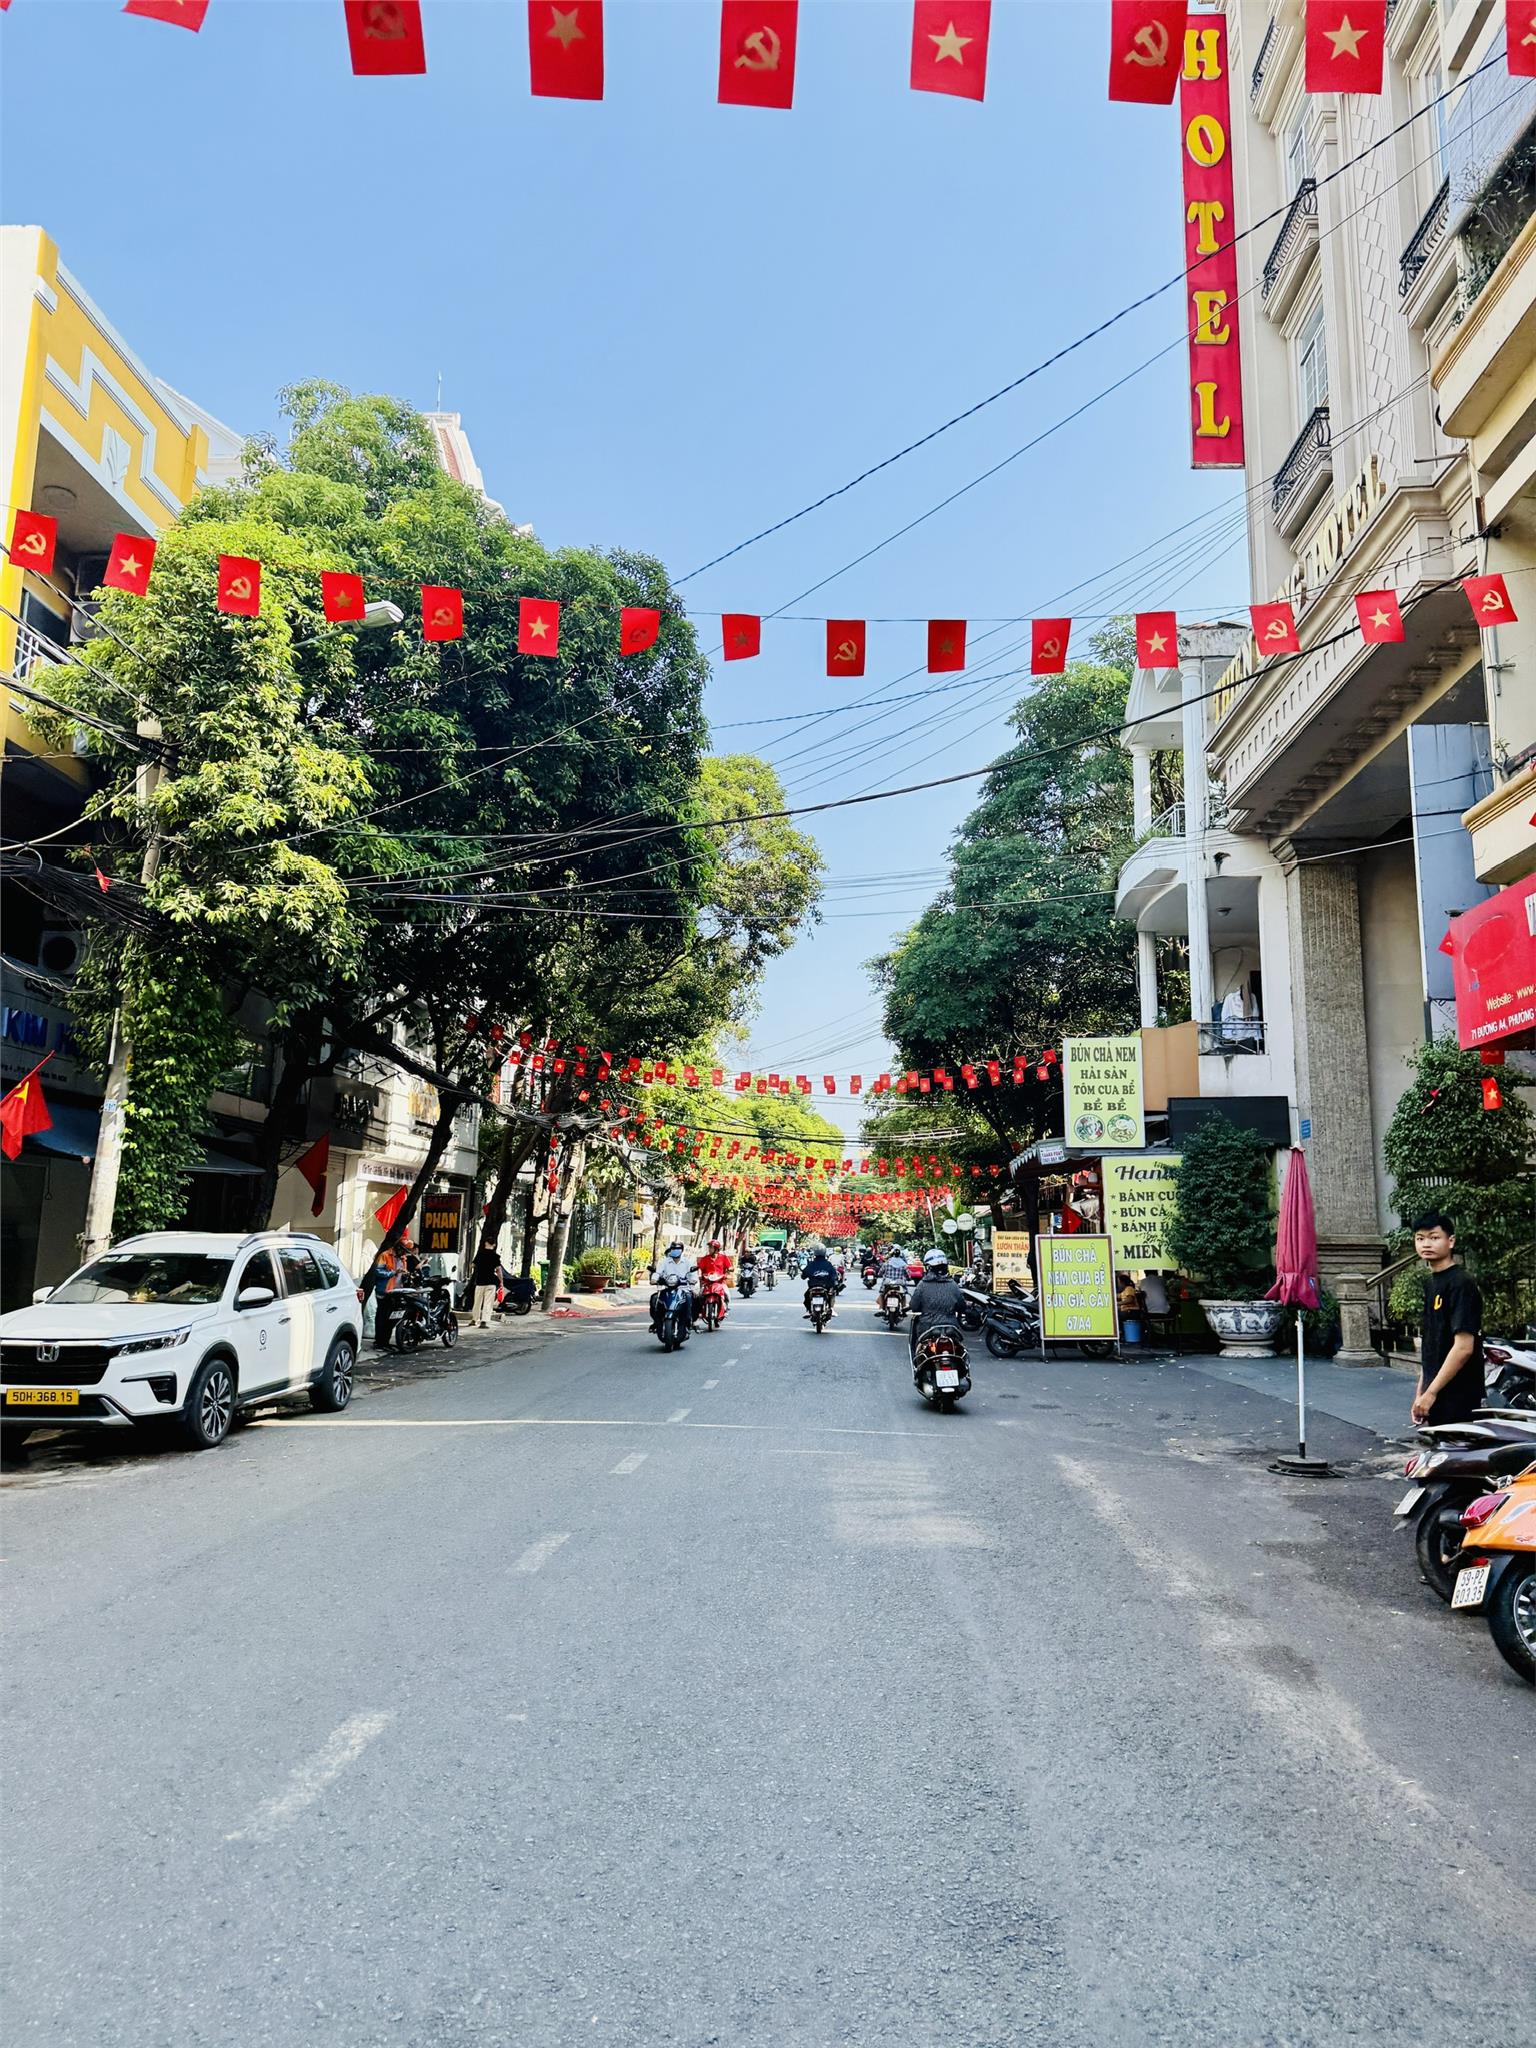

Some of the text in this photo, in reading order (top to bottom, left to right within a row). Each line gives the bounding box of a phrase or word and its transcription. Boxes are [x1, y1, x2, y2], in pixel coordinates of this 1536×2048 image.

[1182, 29, 1231, 438] HOTEL
[1310, 454, 1386, 593] HOTEL
[1485, 992, 1514, 1012] Website:
[1070, 1040, 1136, 1062] BÚN CHẢ NEM
[1074, 1082, 1095, 1095] TÔM
[1098, 1085, 1119, 1095] CUA
[1119, 1188, 1155, 1202] BÁNH
[1120, 1205, 1146, 1217] BÚN
[1121, 1219, 1156, 1232] BÁNH
[1052, 1244, 1073, 1263] BÚN
[1048, 1270, 1068, 1285] NEM
[1070, 1270, 1091, 1285] CUA
[1046, 1289, 1066, 1307] BÚN
